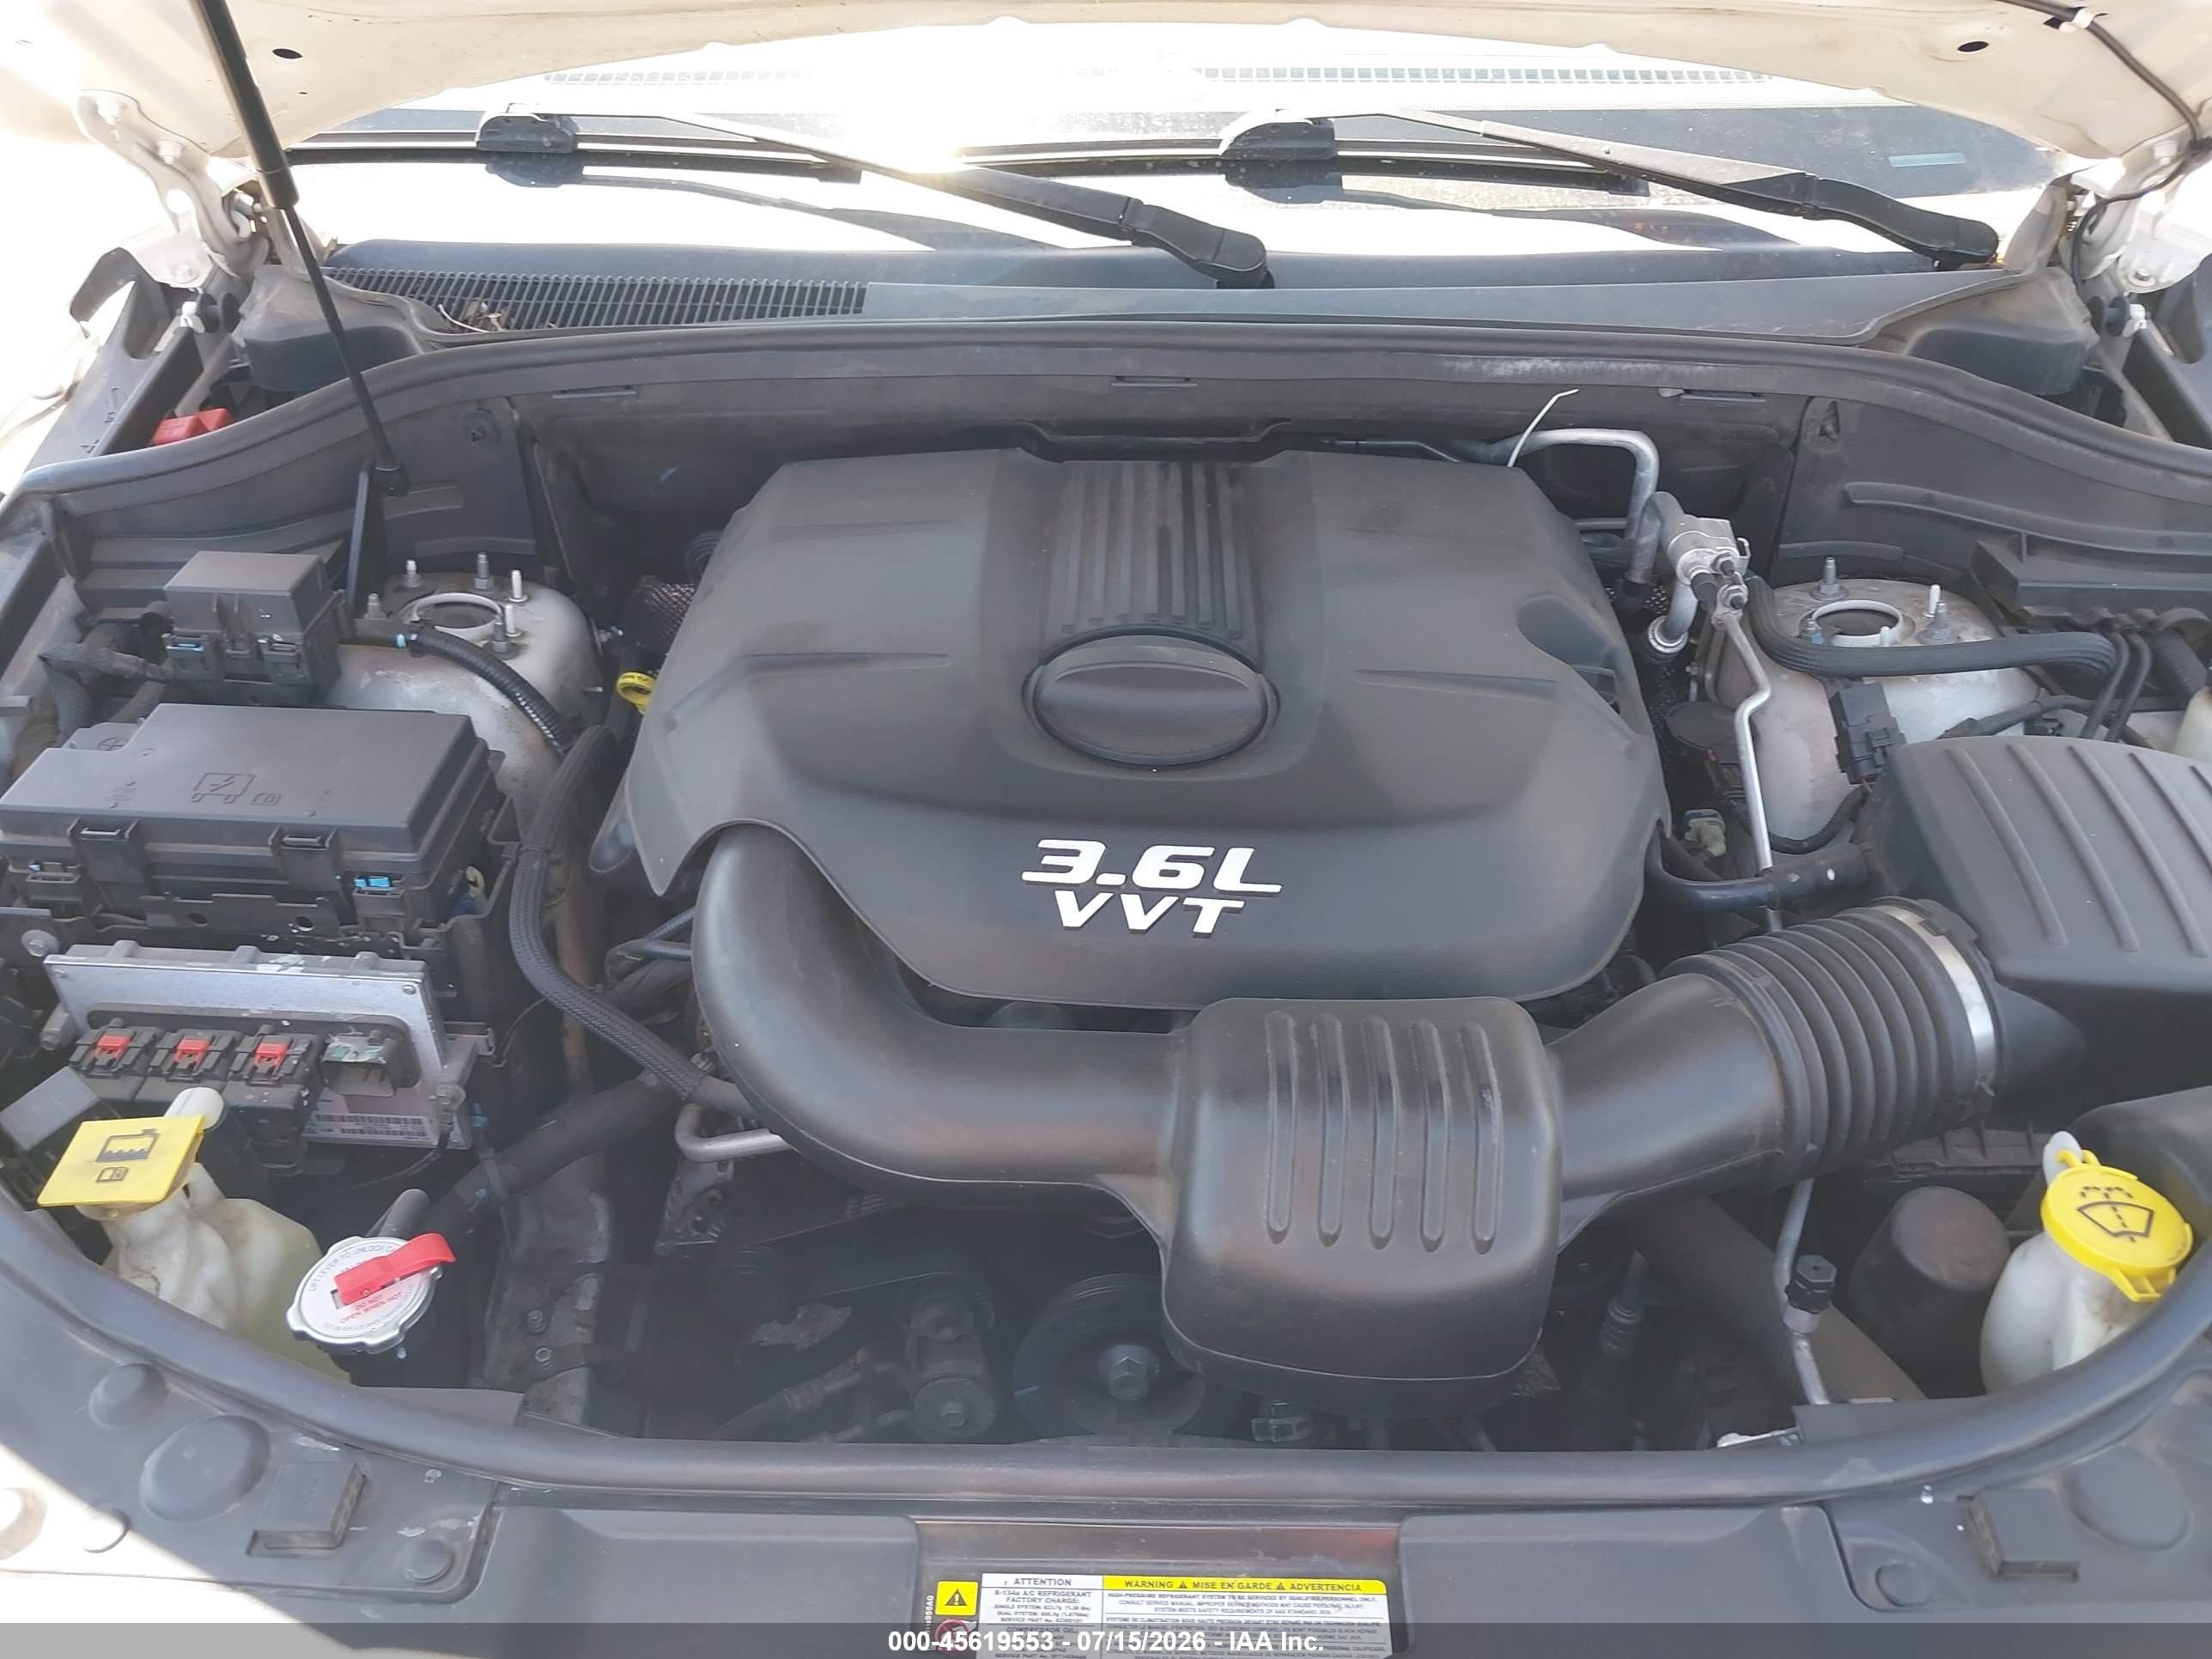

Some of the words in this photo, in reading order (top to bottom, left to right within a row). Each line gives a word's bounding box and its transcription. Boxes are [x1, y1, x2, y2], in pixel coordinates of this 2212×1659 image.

[1021, 839, 1283, 893] 3.6L
[1054, 890, 1246, 937] VVT
[1013, 1577, 1072, 1586] ATTENTION
[1124, 1580, 1173, 1589] WARNING
[1290, 1583, 1362, 1591] ADVERTENCIA
